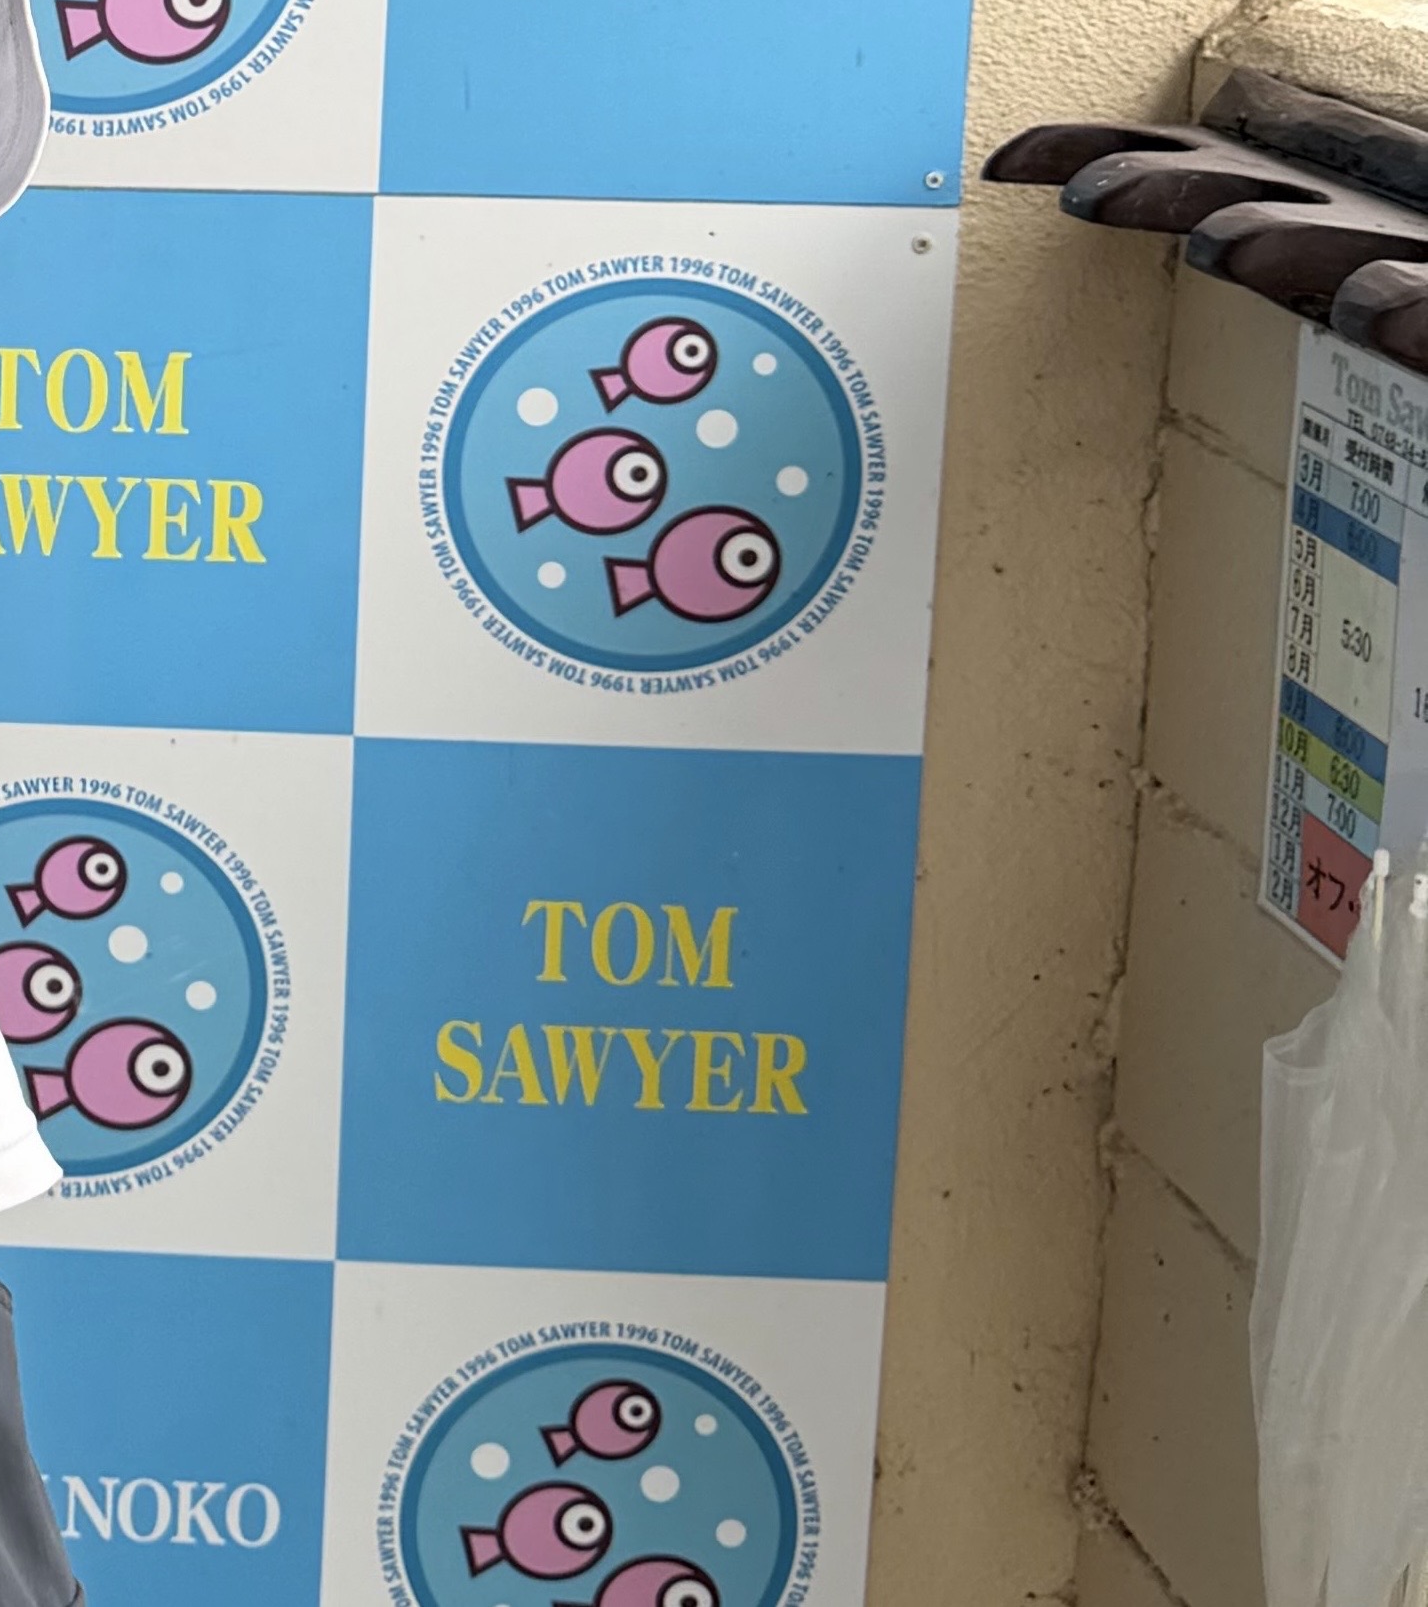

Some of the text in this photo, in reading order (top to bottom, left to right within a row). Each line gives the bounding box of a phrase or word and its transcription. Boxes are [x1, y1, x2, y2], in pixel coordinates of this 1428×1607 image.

[447, 254, 856, 381] SAWYER 1996 TOM SAWYER 1996 TOM SAWYER 1996
[1331, 351, 1382, 418] Tom
[1299, 452, 1324, 493] 3月
[1294, 528, 1317, 570] 5月
[1290, 605, 1373, 663] 7月 5:30
[1278, 716, 1308, 763] 10月
[0, 775, 74, 800] SAWYER
[78, 776, 122, 799] 1996
[124, 784, 163, 814] TOM
[162, 802, 228, 856] SAWYER
[222, 850, 258, 892] 1996
[1274, 753, 1357, 839] 11月 7:00
[522, 900, 738, 988] TOM
[434, 1020, 808, 1115] SAWYER
